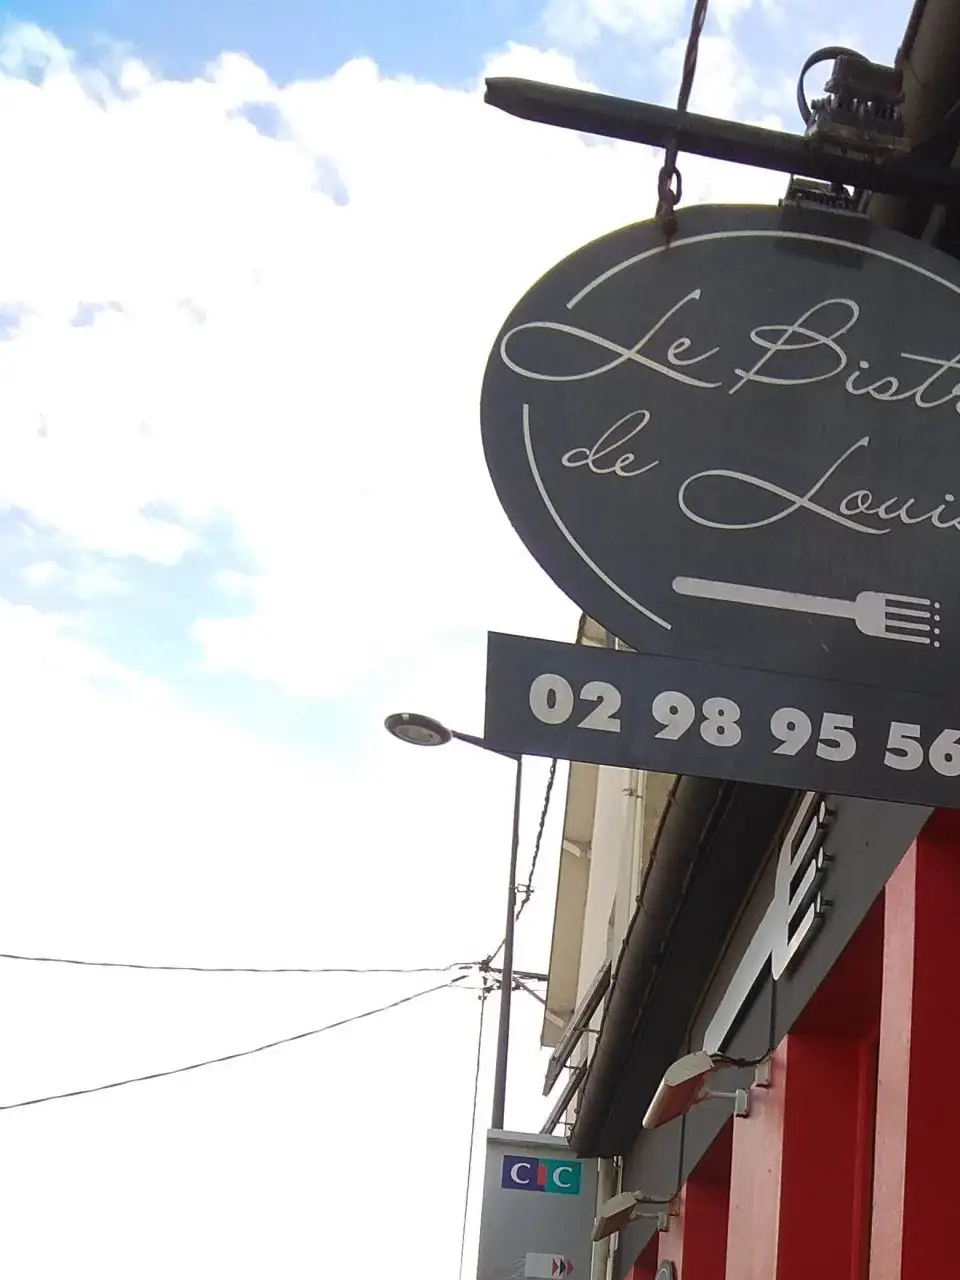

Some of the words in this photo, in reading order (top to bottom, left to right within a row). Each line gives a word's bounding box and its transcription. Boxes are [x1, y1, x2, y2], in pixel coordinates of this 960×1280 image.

[501, 289, 720, 388] Le
[562, 410, 660, 477] de
[529, 673, 622, 733] 02
[651, 690, 742, 747] 98
[770, 707, 857, 762] 95
[510, 1162, 573, 1188] CIC
